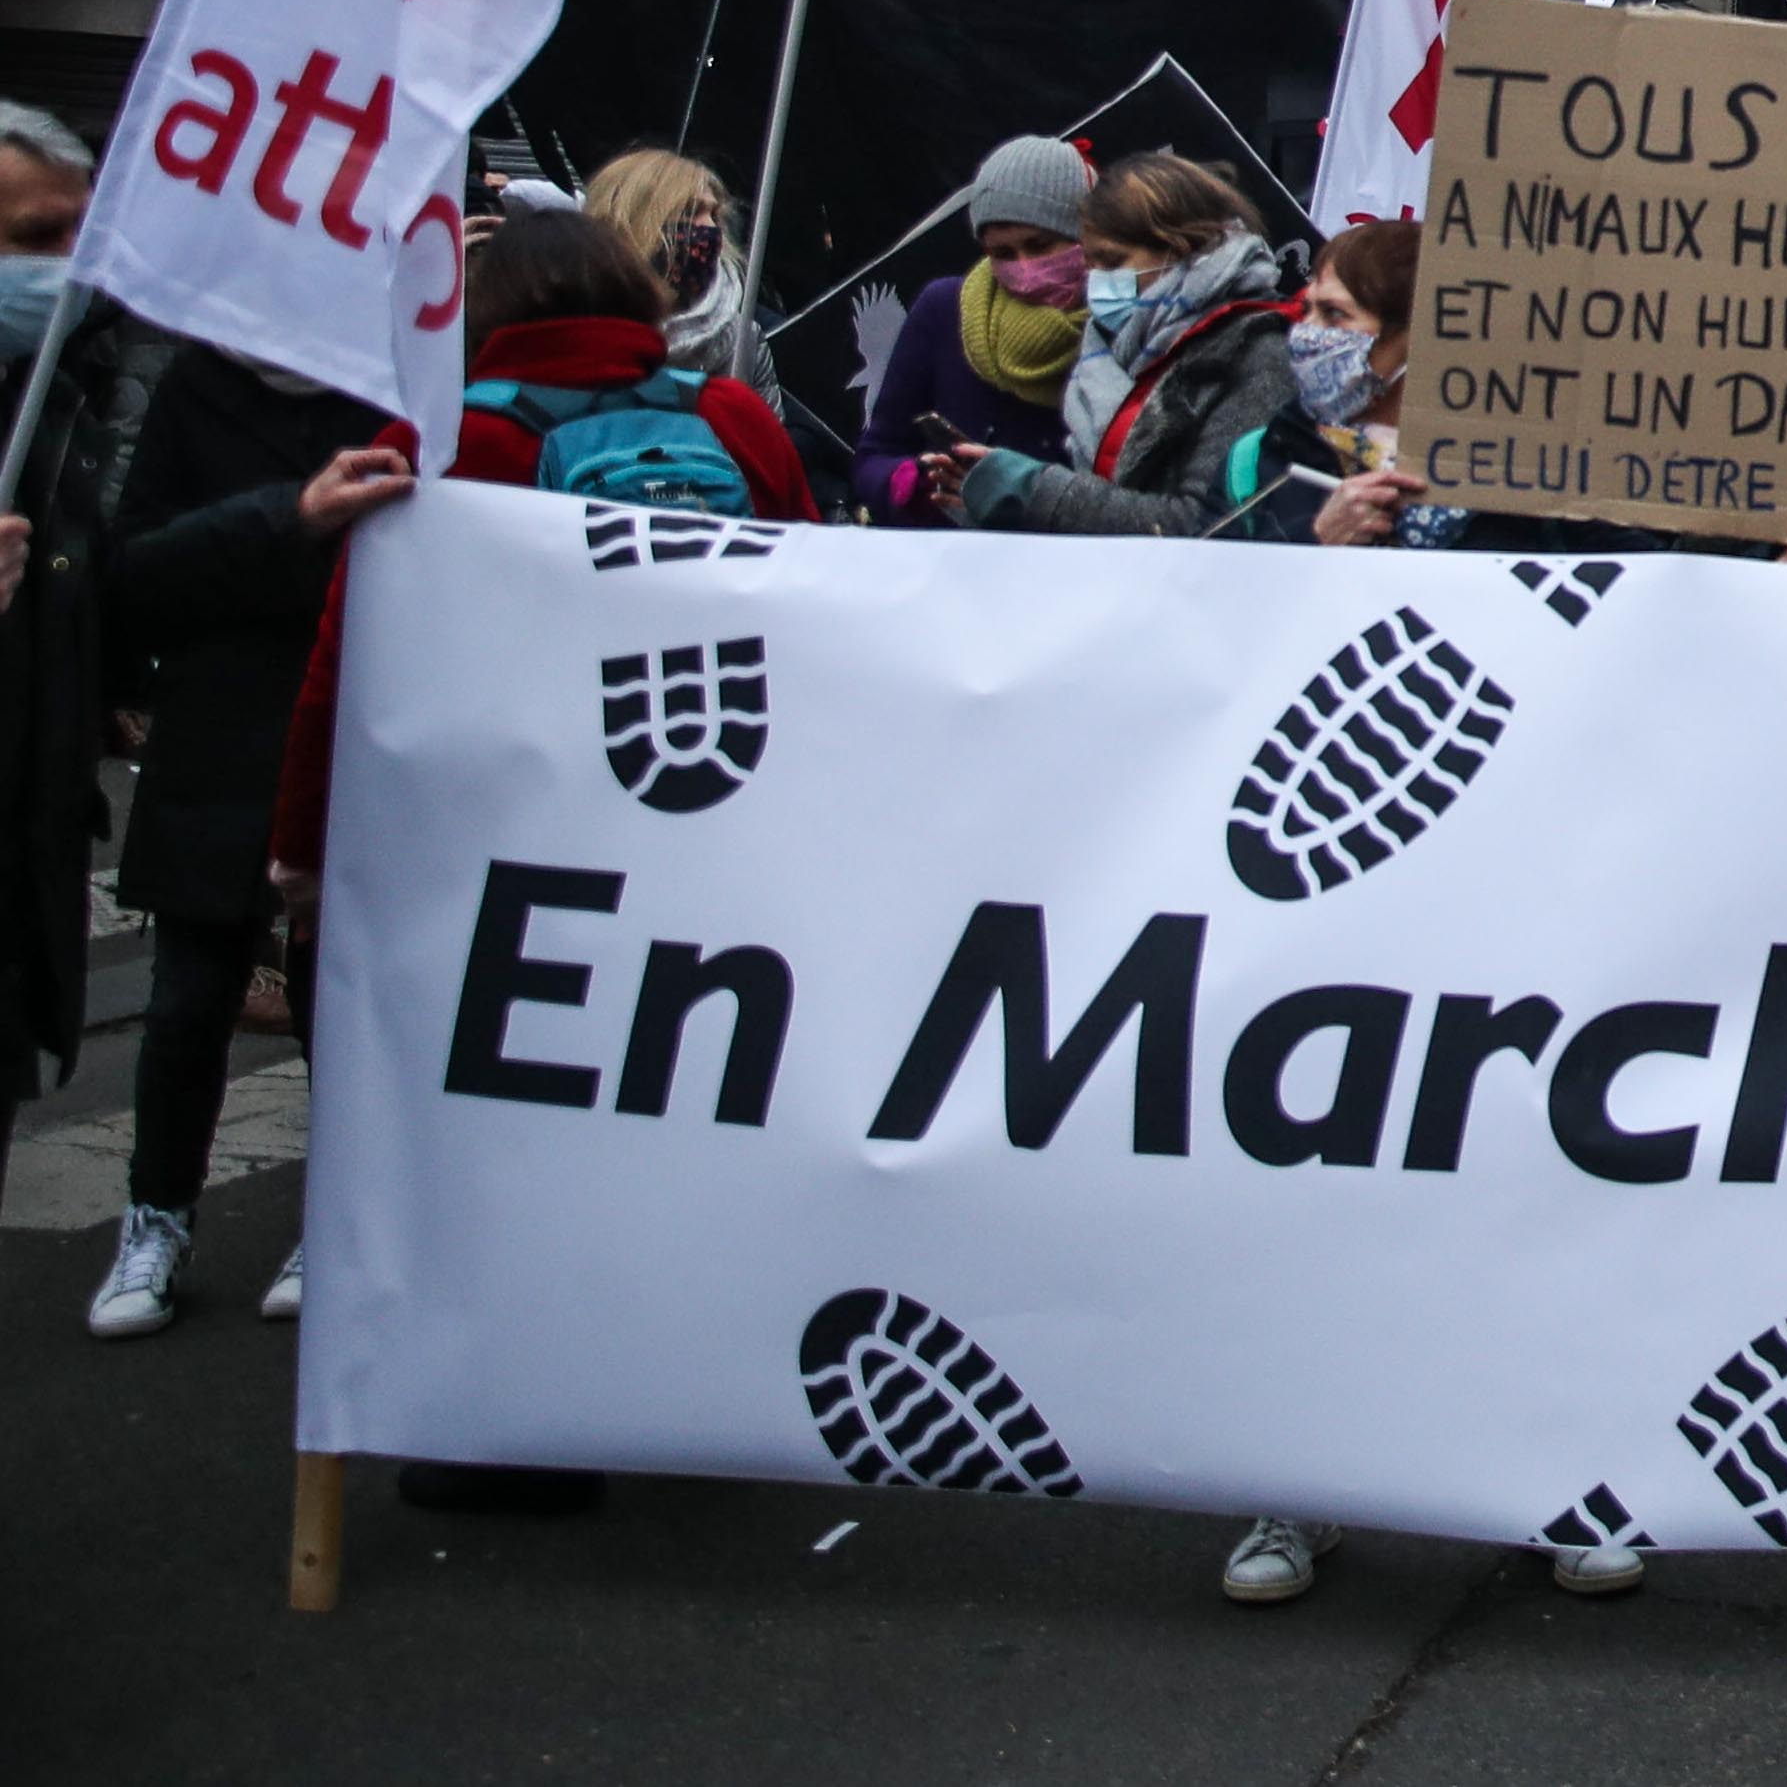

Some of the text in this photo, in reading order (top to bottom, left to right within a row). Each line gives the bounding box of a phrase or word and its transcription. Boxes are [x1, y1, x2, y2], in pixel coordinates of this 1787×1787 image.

[1452, 64, 1778, 172] TOUS
[1433, 279, 1511, 342] ET
[1525, 285, 1669, 344] NON
[1439, 362, 1581, 420] ONT
[1602, 370, 1695, 435] UN
[442, 857, 796, 1129] En
